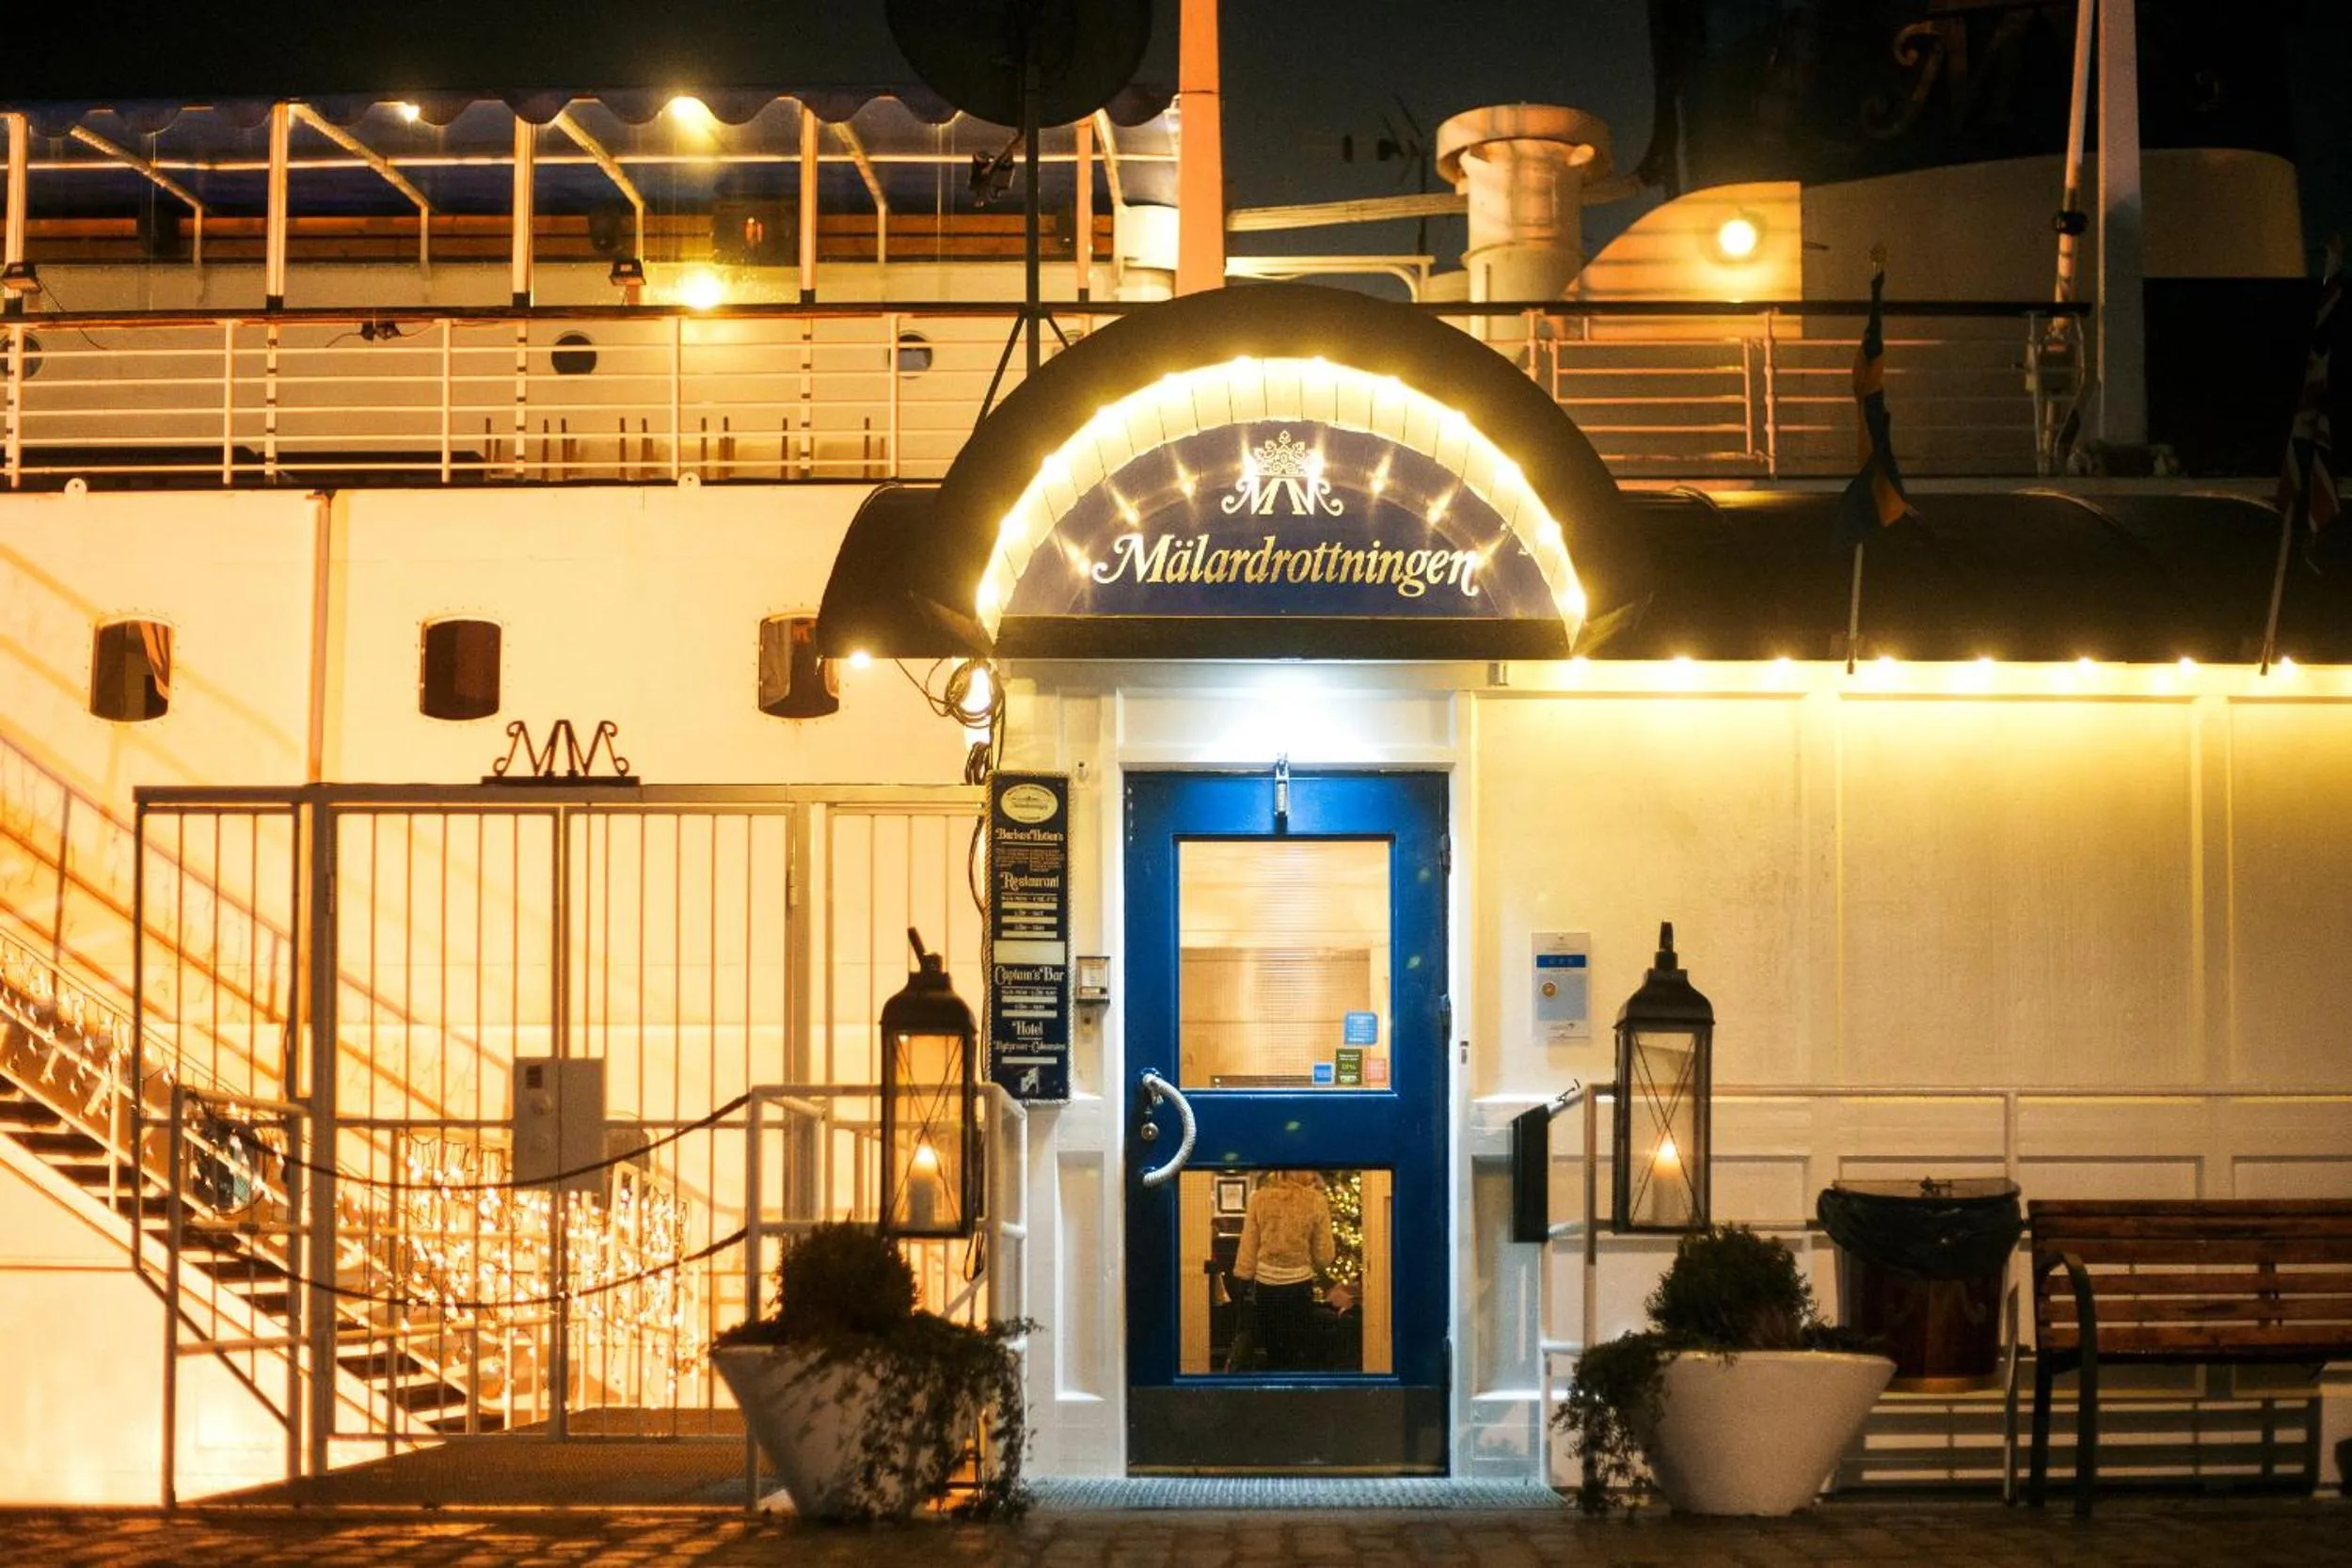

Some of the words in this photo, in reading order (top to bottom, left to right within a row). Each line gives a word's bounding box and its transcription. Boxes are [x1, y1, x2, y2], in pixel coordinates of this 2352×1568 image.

[1092, 532, 1480, 596] Mälardrottningen
[999, 871, 1059, 892] Restaurant
[994, 965, 1041, 985] Captain's
[1039, 966, 1065, 982] Bar
[1011, 1021, 1043, 1036] Hotel
